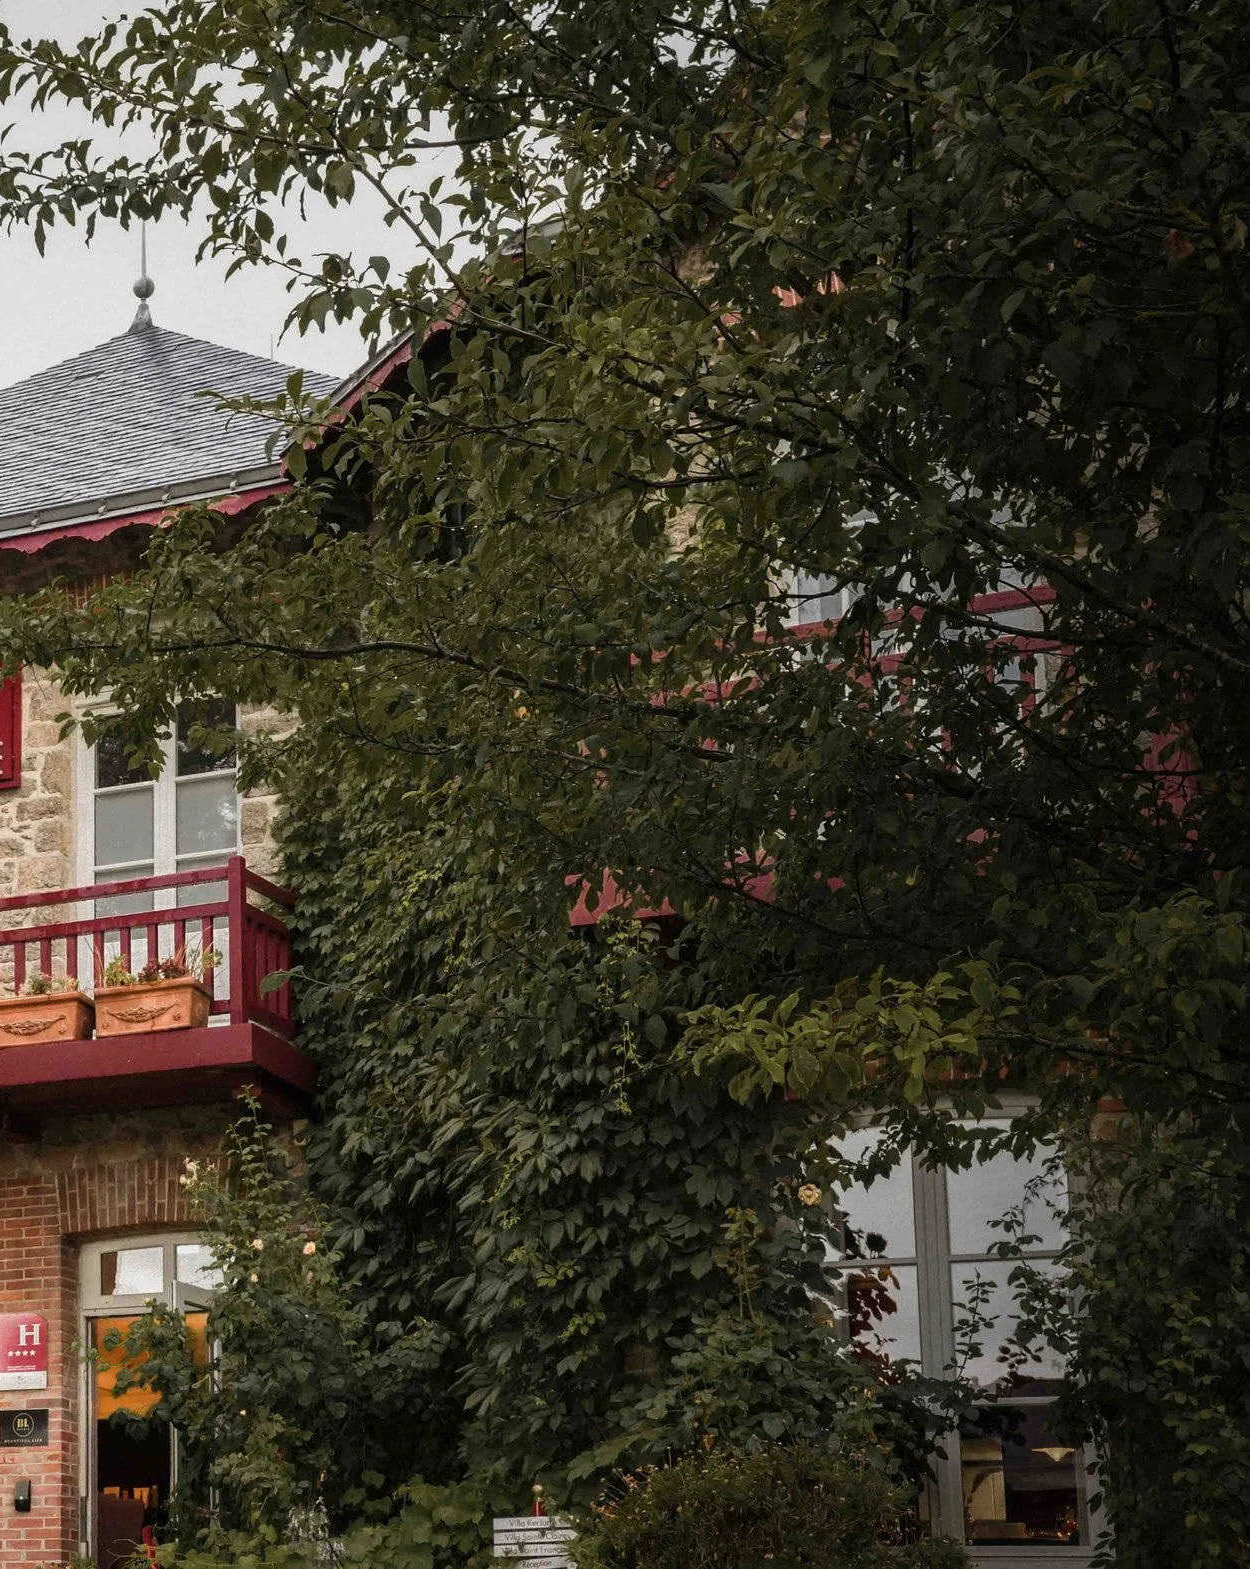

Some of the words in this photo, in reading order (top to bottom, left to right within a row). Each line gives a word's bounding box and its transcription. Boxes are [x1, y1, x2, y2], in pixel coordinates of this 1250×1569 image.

[18, 1323, 41, 1346] H
[509, 1519, 526, 1528] Villa
[504, 1533, 521, 1541] Villa
[501, 1546, 517, 1555] Vlla
[522, 1560, 552, 1569] Réception
